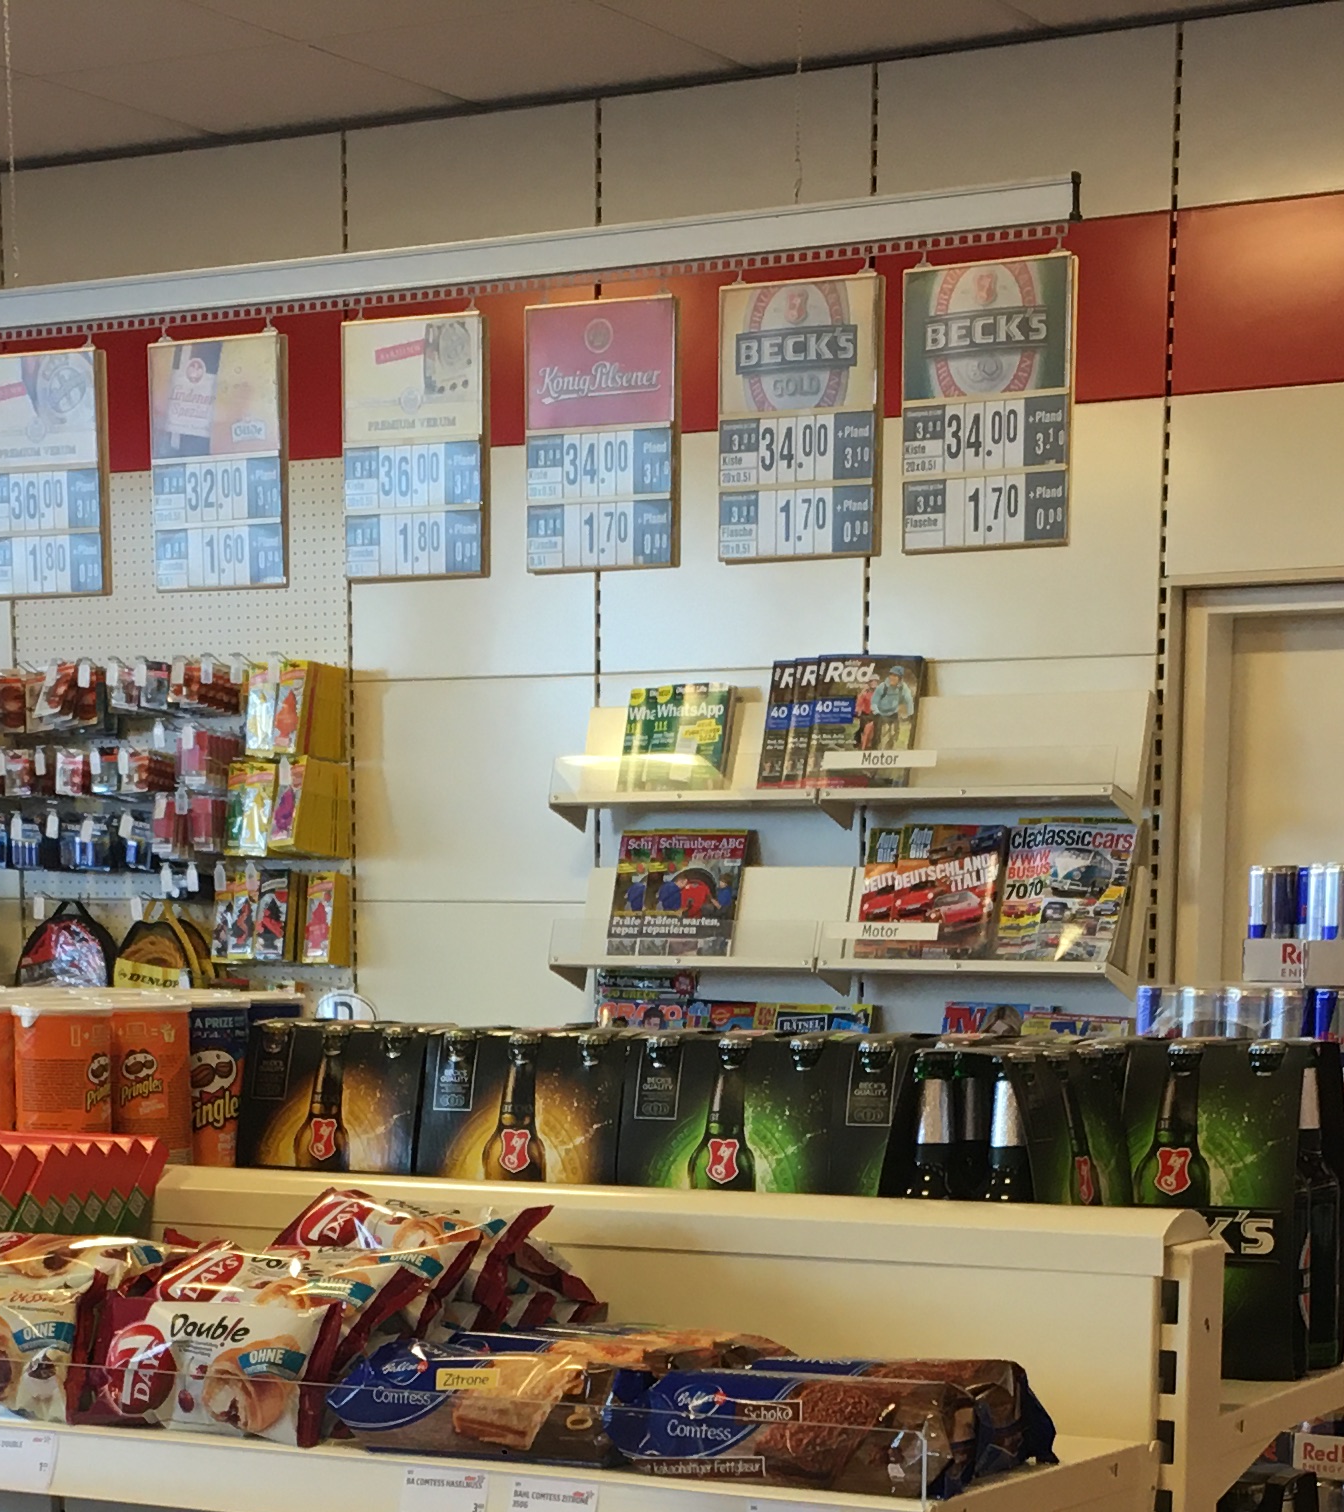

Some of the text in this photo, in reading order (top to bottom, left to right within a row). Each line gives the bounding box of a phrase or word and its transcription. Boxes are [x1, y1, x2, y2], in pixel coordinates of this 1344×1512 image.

[925, 309, 1048, 351] BECK'S
[739, 327, 855, 368] BECK'S
[773, 374, 821, 398] GOLD
[367, 416, 456, 431] PREMIUM VERUM
[946, 409, 1017, 459] 34.00
[761, 424, 828, 471] 34.00
[381, 452, 440, 498] 36.00
[187, 466, 242, 512] 32.00
[969, 483, 1018, 533] 1.70
[780, 497, 827, 542] 1.70
[906, 516, 938, 528] Flasche
[399, 520, 441, 563] 1.80
[205, 533, 245, 574] 1.60
[657, 704, 724, 719] WhatsApp
[770, 706, 788, 719] 40
[792, 703, 809, 716] 40
[815, 700, 833, 713] 40
[861, 752, 899, 767] Motor
[659, 837, 745, 852] Schrauber-ABC
[862, 924, 899, 938] Motor
[205, 1016, 234, 1029] PRIZE
[120, 1077, 163, 1107] Pringles
[23, 1322, 57, 1341] OHNE
[170, 1312, 251, 1348] Double
[249, 1347, 285, 1365] OHNE
[442, 1370, 491, 1388] Zitrone
[372, 1386, 432, 1407] Comtess
[742, 1403, 794, 1422] Schoko
[666, 1418, 733, 1442] Comtess
[513, 1489, 529, 1499] BAHL
[530, 1491, 560, 1503] COMTESS
